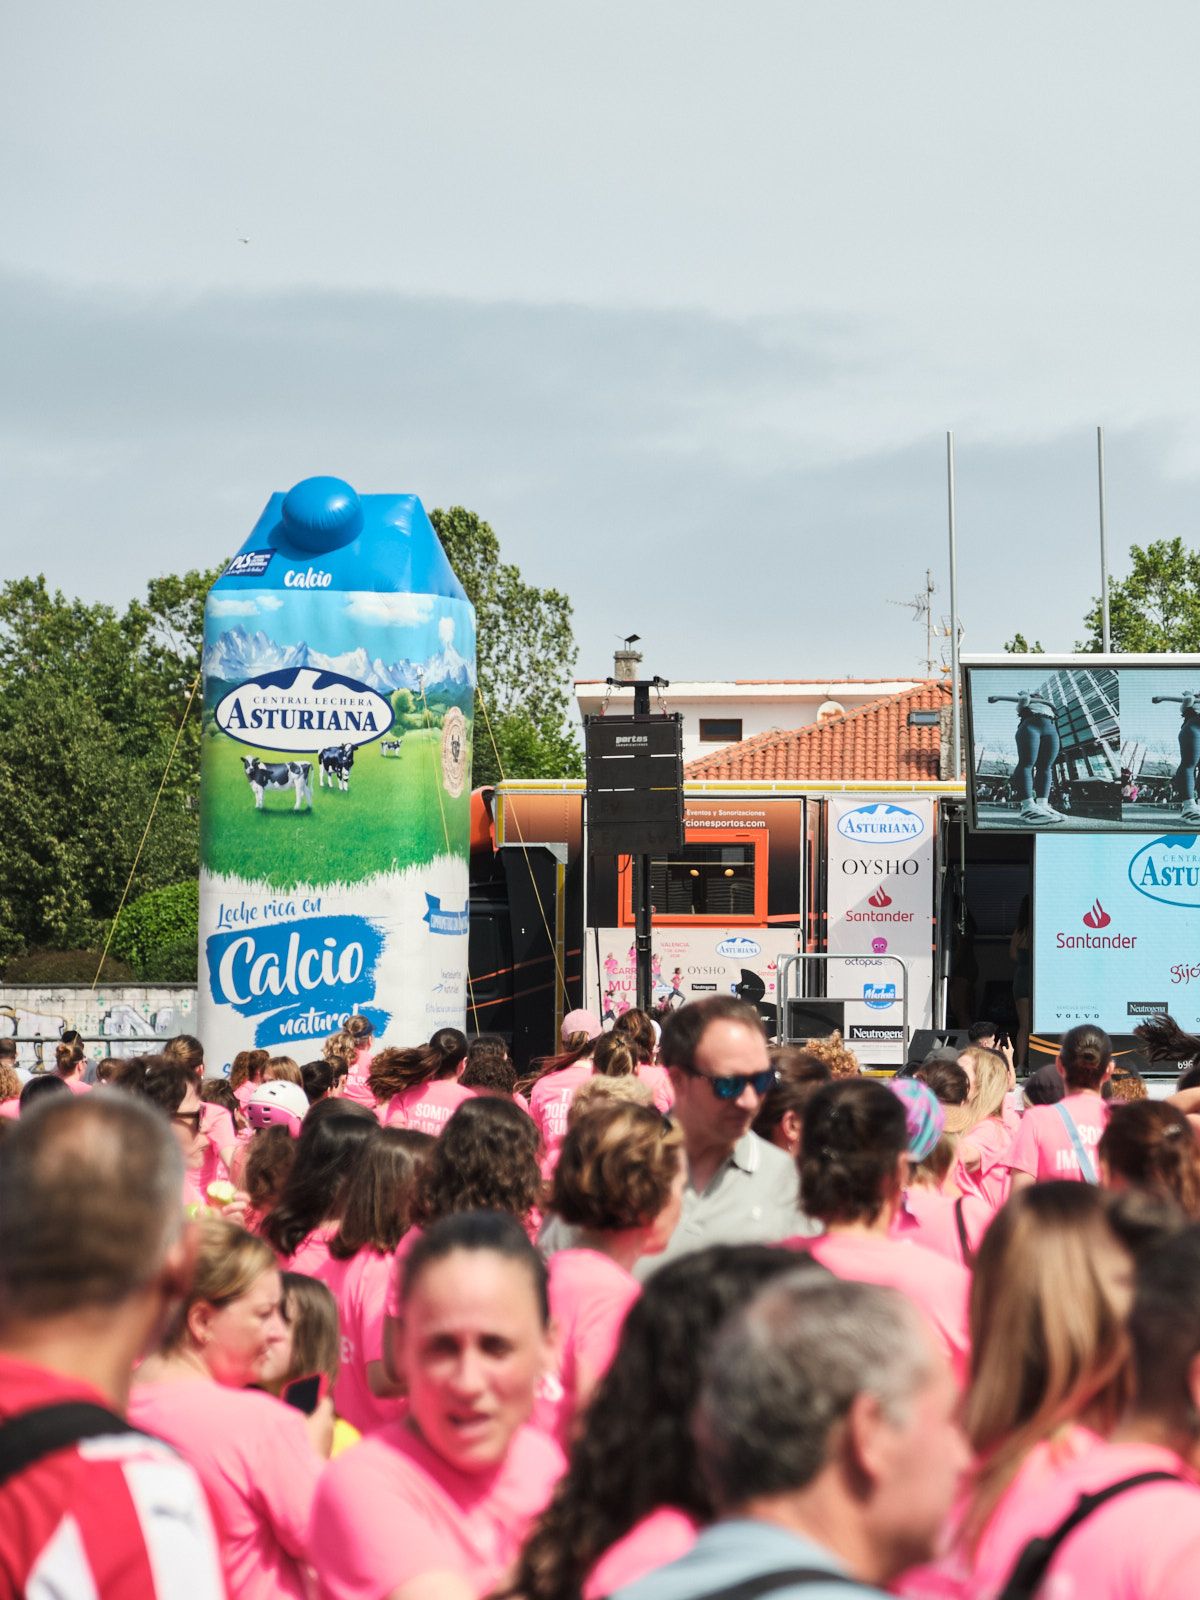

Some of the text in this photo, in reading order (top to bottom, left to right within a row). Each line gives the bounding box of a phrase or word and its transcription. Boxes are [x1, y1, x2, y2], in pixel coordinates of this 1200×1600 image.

[253, 696, 373, 706] CENTRAL LECHERA
[225, 697, 378, 732] ASTURIANA
[687, 809, 711, 818] Eventos
[719, 809, 765, 817] Sonorizaciones
[684, 818, 766, 829] cionesportos.com
[844, 818, 917, 833] ASTURIANA
[842, 858, 919, 876] OYSHO
[217, 900, 258, 930] Leche
[263, 899, 296, 919] rica
[845, 910, 914, 922] Santander
[1056, 932, 1137, 949] Santander
[218, 931, 364, 1005] Calcio
[844, 957, 882, 967] octopus
[687, 966, 726, 975] OYSHO
[1129, 1004, 1166, 1014] Neutrogena
